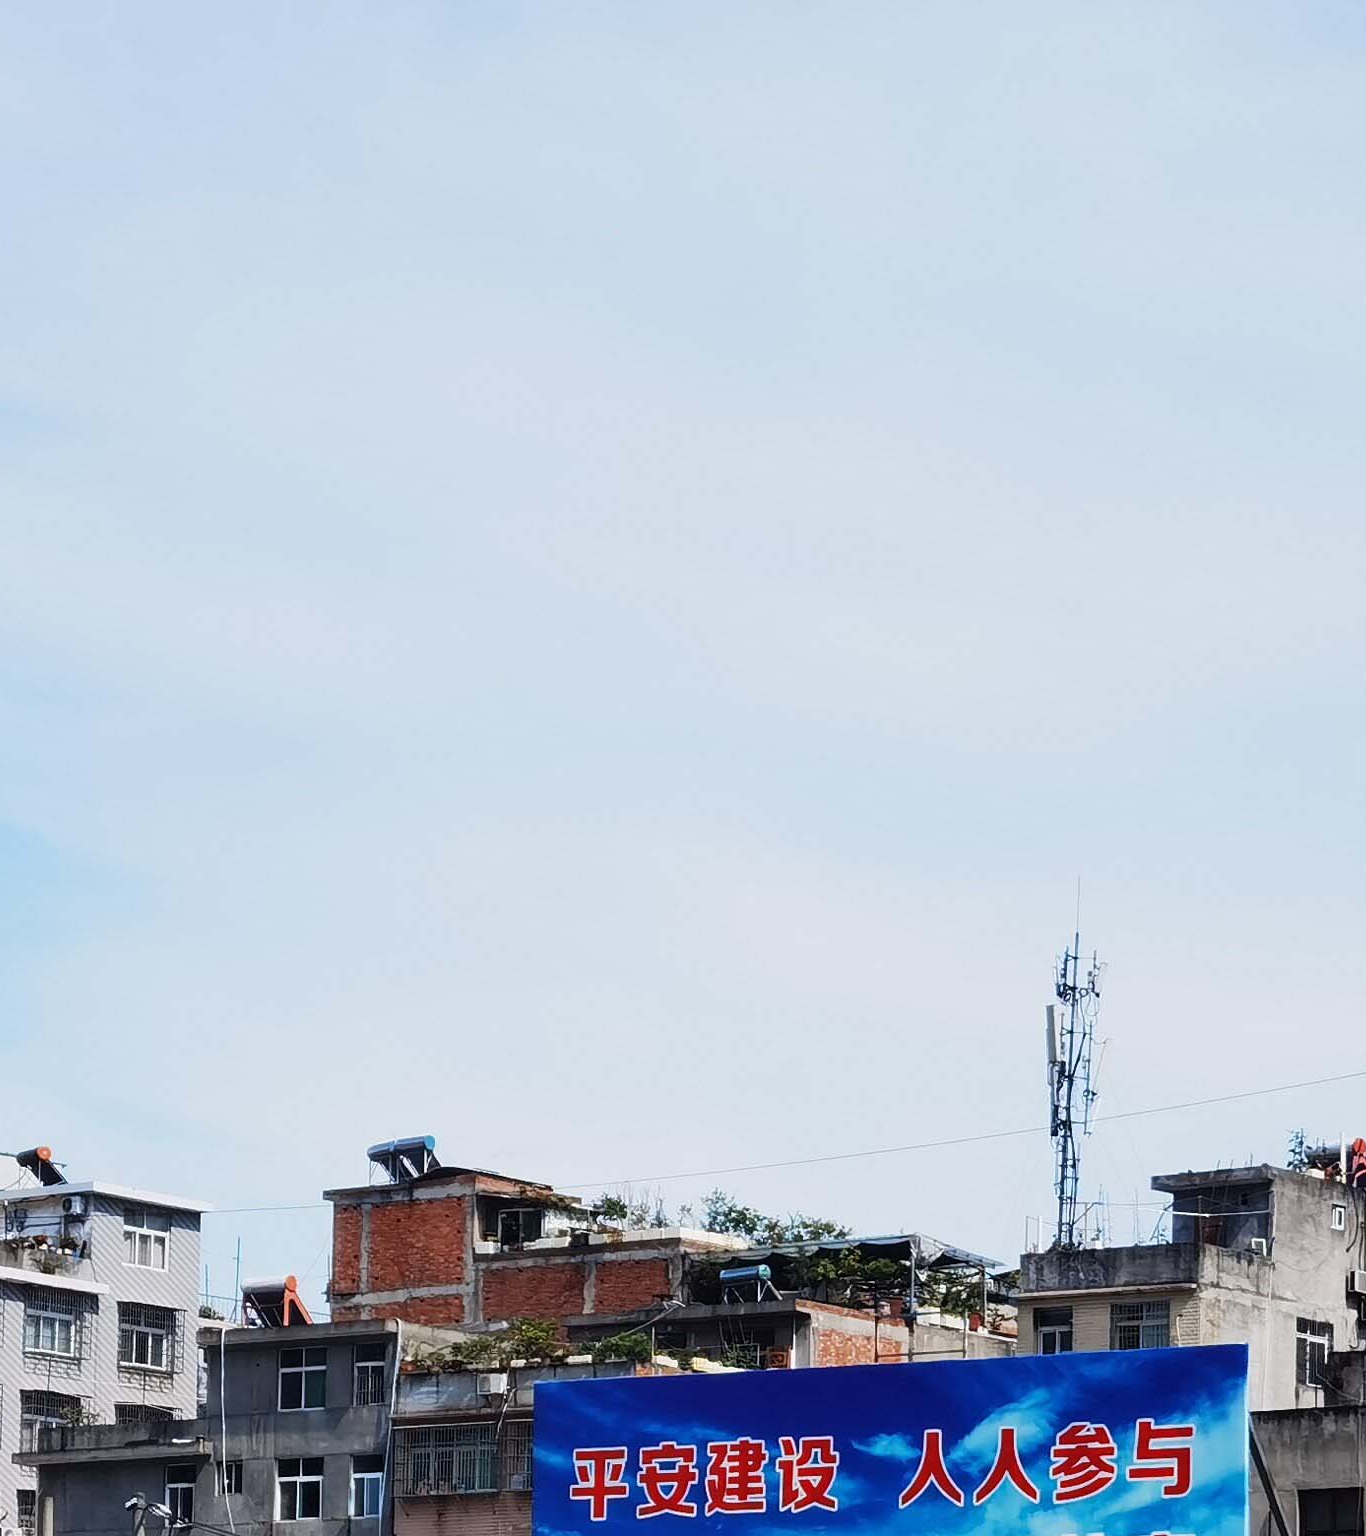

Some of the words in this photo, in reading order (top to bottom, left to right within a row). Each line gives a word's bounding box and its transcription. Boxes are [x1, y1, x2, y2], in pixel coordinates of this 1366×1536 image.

[569, 1435, 839, 1522] 平安建设
[898, 1418, 1196, 1510] 人人参与
